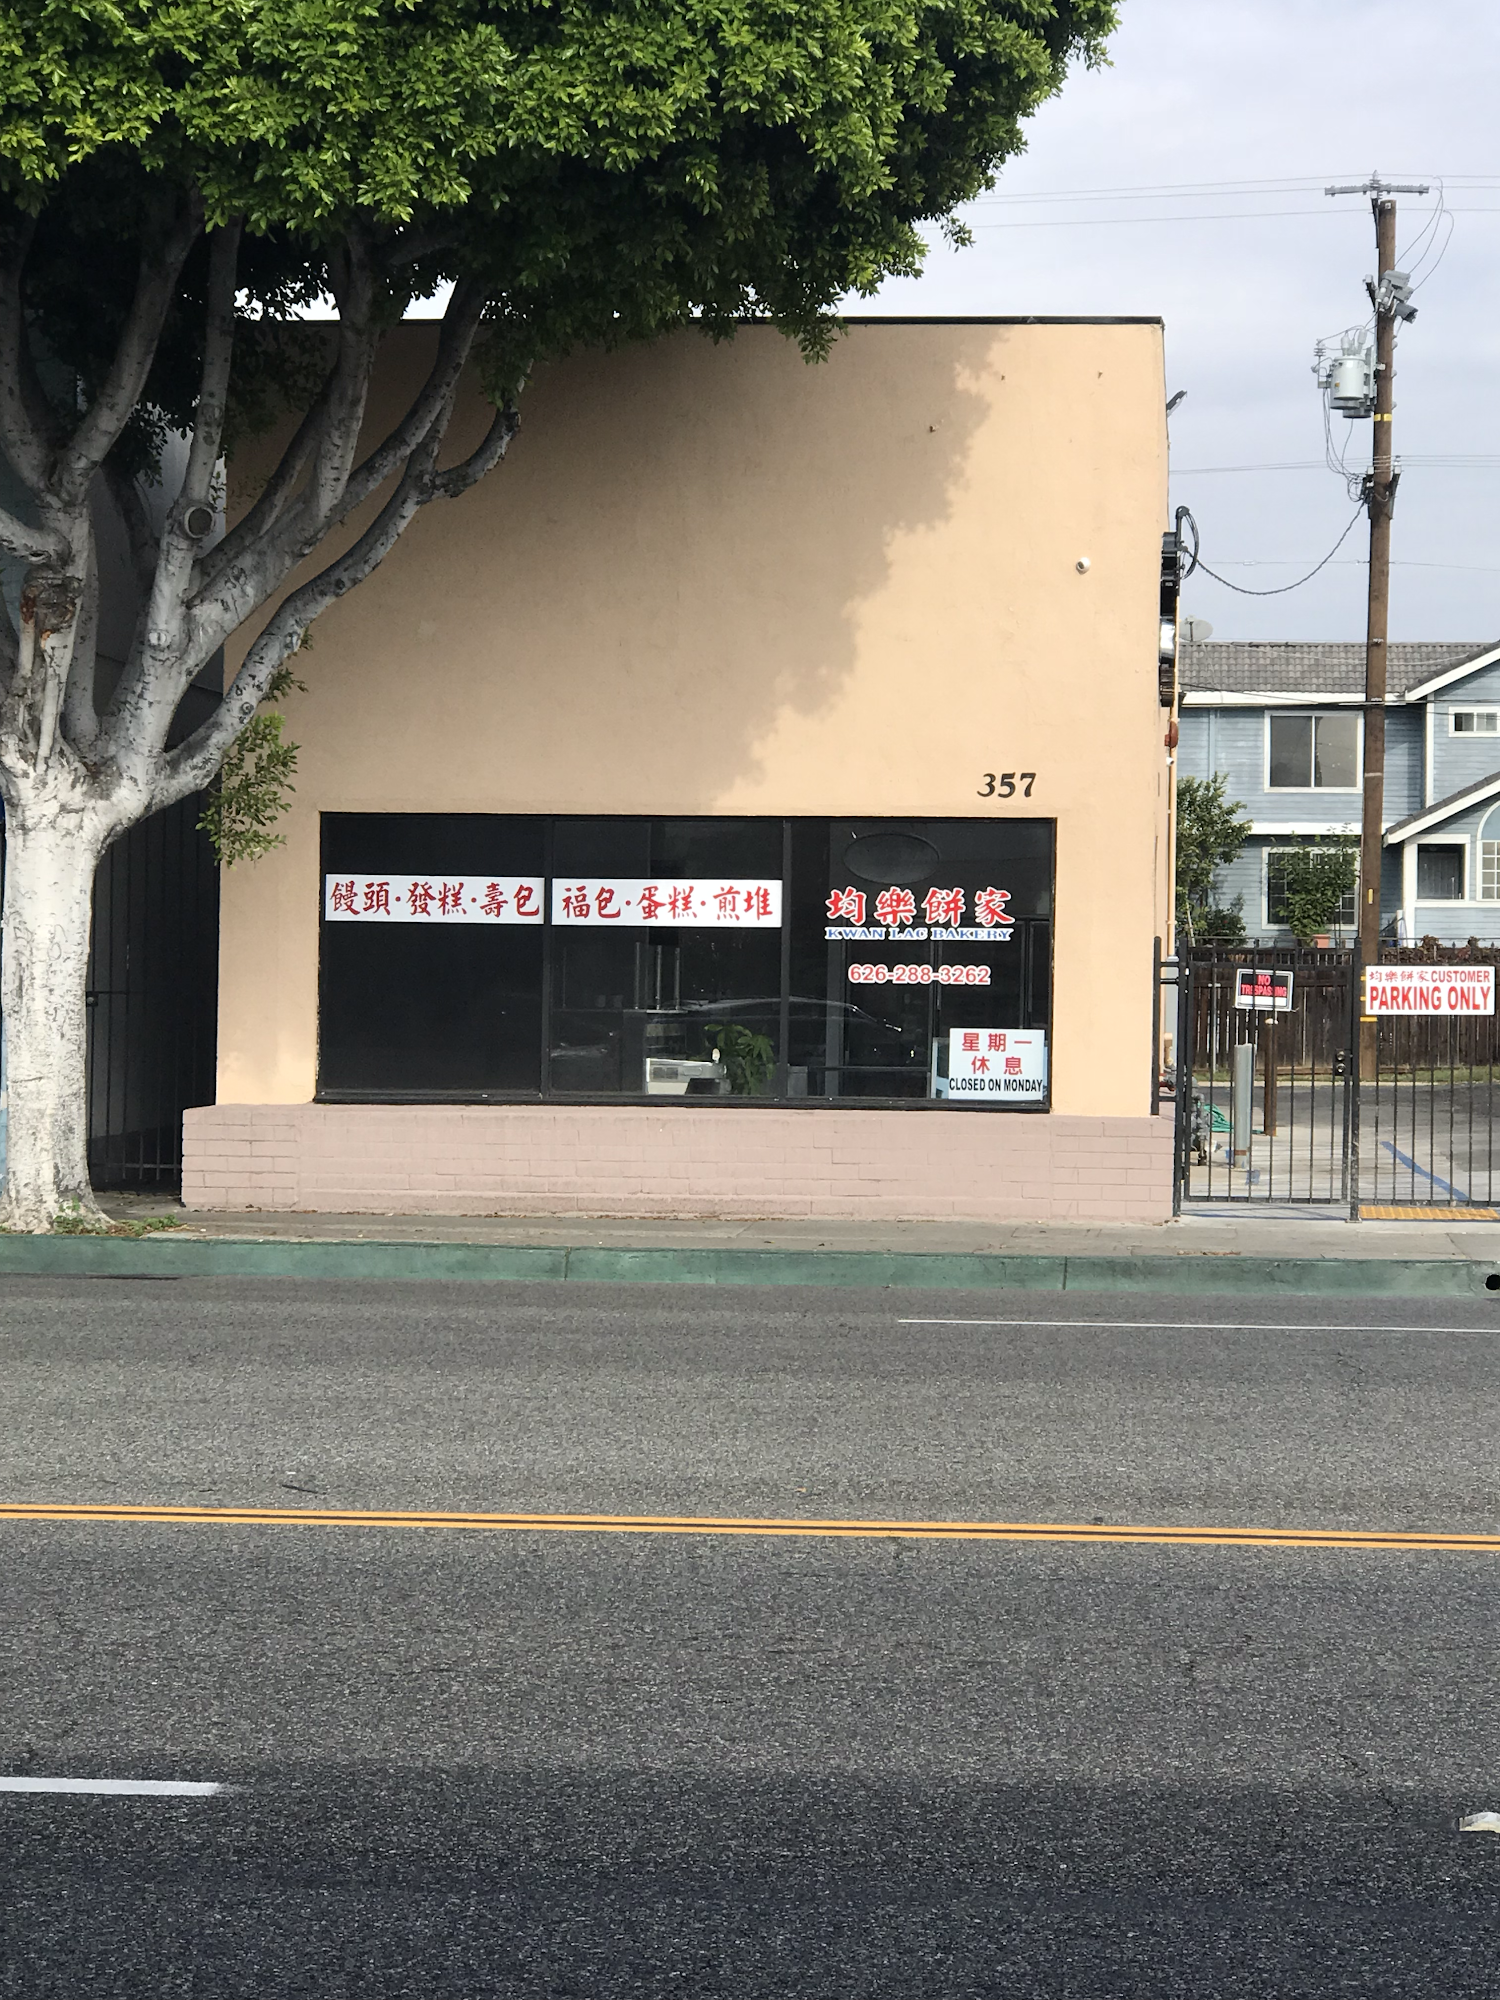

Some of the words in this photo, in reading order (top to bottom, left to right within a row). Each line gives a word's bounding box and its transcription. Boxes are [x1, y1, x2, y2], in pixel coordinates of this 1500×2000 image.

[976, 772, 1037, 798] 357
[825, 886, 1016, 927] 均樂餅家
[826, 927, 885, 940] KWAN
[931, 928, 1013, 941] BAKERY
[849, 965, 991, 985] 626-288-3262
[1257, 974, 1271, 986] NO
[1431, 970, 1491, 983] CUSTOMER
[1241, 983, 1287, 997] TRSPASING
[1369, 986, 1442, 1010] PARKING
[1447, 986, 1491, 1010] ONLY
[962, 1032, 1032, 1052] 星期一
[971, 1056, 1023, 1075] 休息
[949, 1078, 986, 1091] CLOSED
[988, 1079, 1001, 1091] ON
[1004, 1079, 1043, 1092] MONDAY
